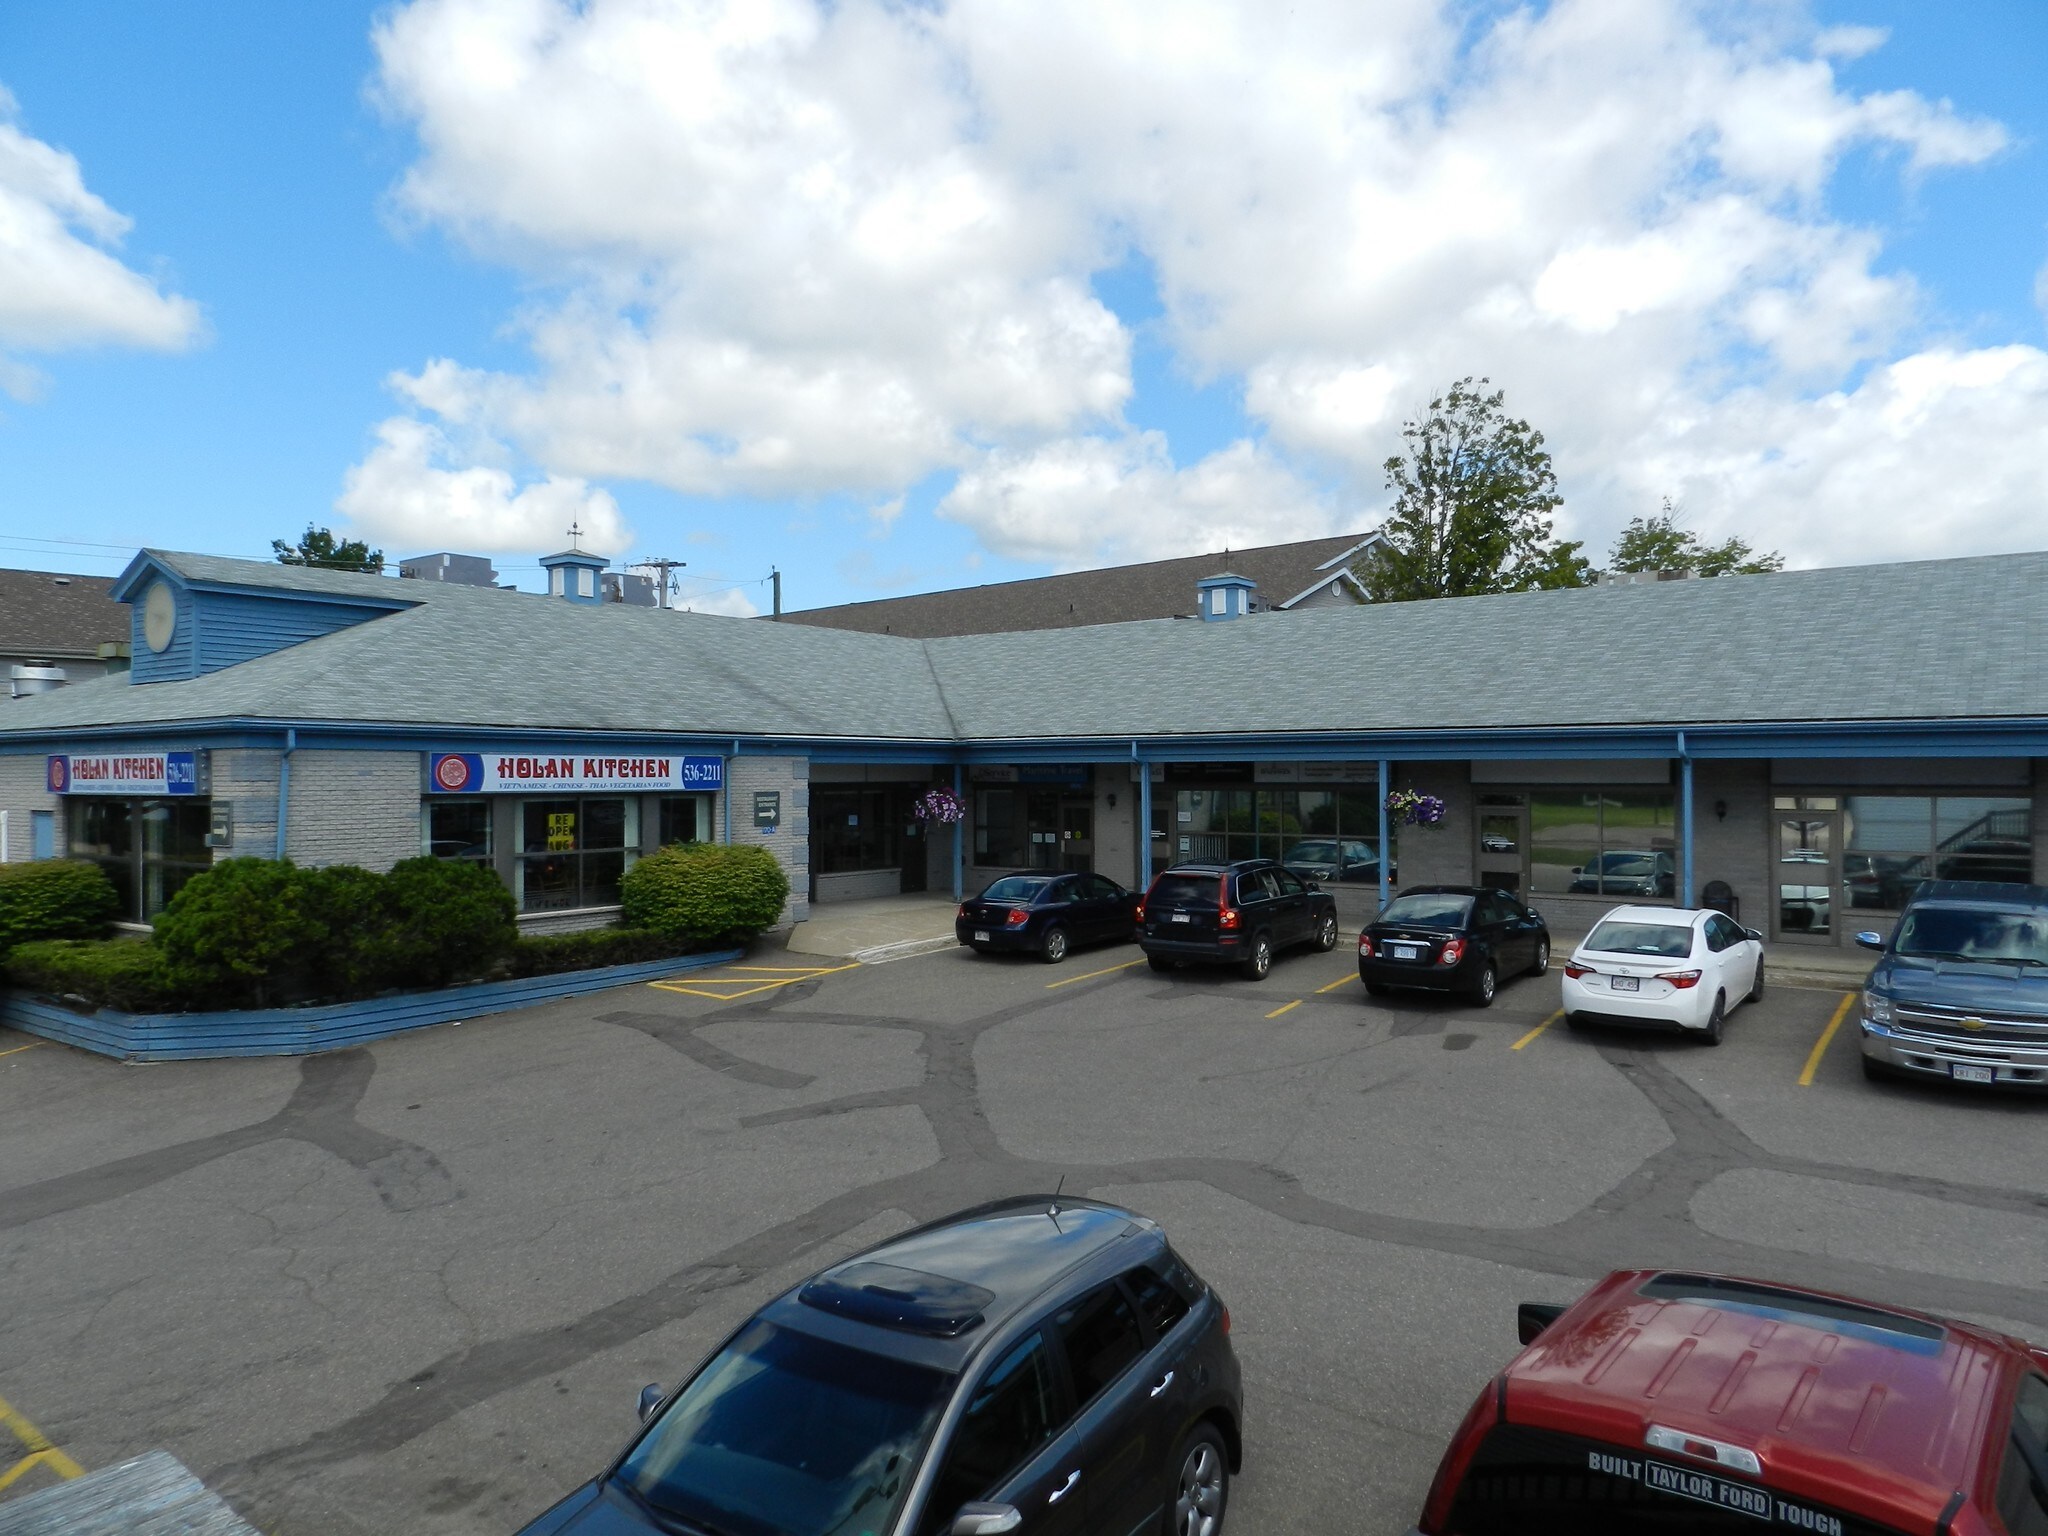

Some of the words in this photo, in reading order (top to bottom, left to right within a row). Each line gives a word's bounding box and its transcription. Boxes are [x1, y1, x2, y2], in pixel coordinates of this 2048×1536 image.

[73, 759, 109, 779] HOLAN
[113, 758, 164, 779] KITCHEN
[497, 758, 574, 778] HOLAN
[583, 758, 670, 778] KITCHEN
[684, 764, 721, 781] 536-2211
[555, 815, 569, 825] RE
[547, 826, 575, 836] OPEN
[549, 840, 569, 850] AUG
[1588, 1452, 1642, 1480] BUILT
[1651, 1465, 1713, 1499] TAYLOR
[1719, 1484, 1766, 1514] FORD
[1777, 1501, 1842, 1536] TOUGH
